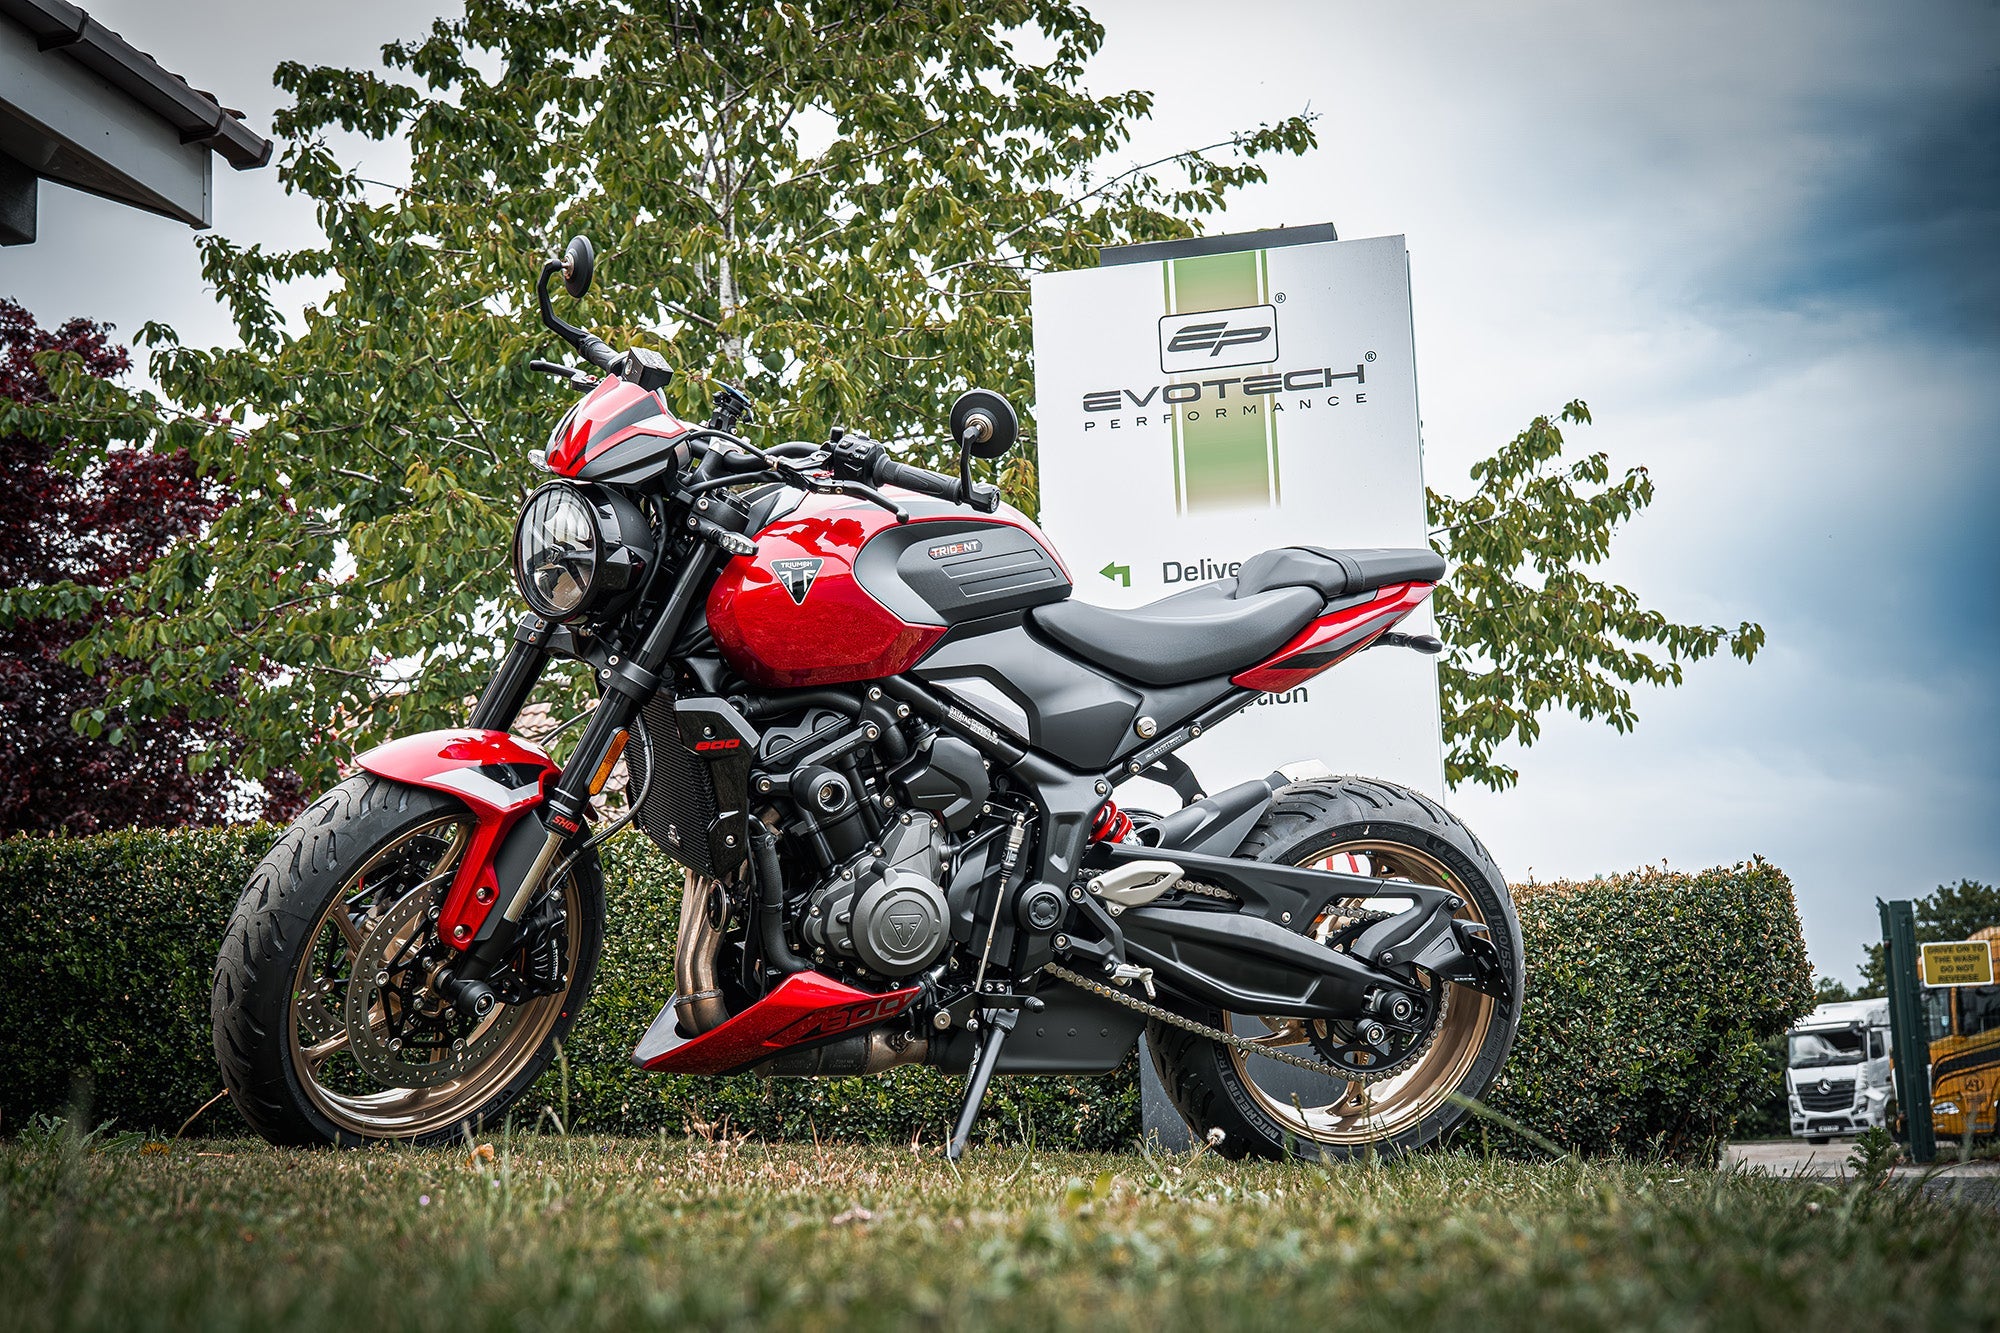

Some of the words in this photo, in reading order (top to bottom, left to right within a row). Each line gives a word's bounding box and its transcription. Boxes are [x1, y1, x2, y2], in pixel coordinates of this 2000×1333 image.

[1082, 364, 1365, 412] EVOTECH
[1084, 393, 1367, 432] PERFORMANCE
[780, 560, 813, 569] TRIUMPH
[931, 540, 979, 557] TRIDENT
[1163, 558, 1242, 584] Delive
[1496, 919, 1512, 969] 180/55
[1227, 1080, 1280, 1140] MICHELIN
